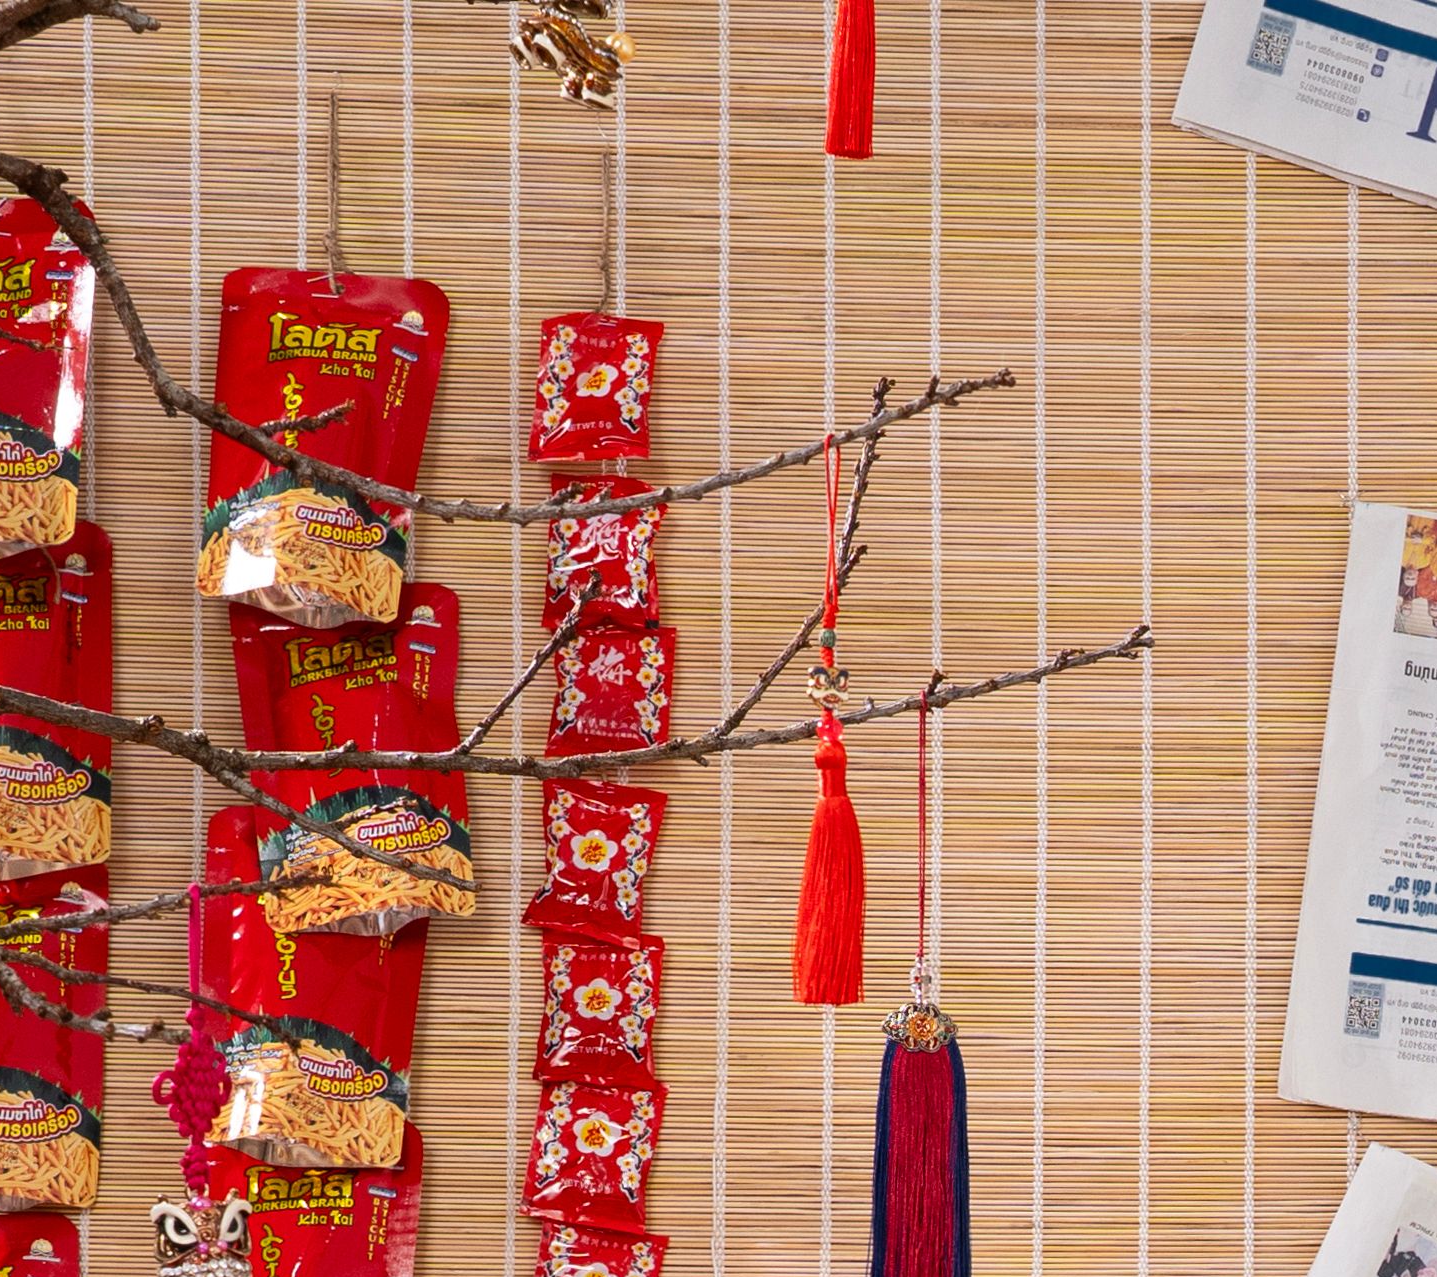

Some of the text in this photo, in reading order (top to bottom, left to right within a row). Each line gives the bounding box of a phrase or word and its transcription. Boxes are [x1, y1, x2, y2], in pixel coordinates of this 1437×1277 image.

[269, 312, 383, 352] โลตัส
[268, 348, 379, 364] DORKBUA BRAND
[305, 519, 383, 548] ทรงเครื่อง
[5, 603, 49, 618] BRAND
[587, 645, 633, 688] 梅
[246, 1166, 355, 1204] โลตัส
